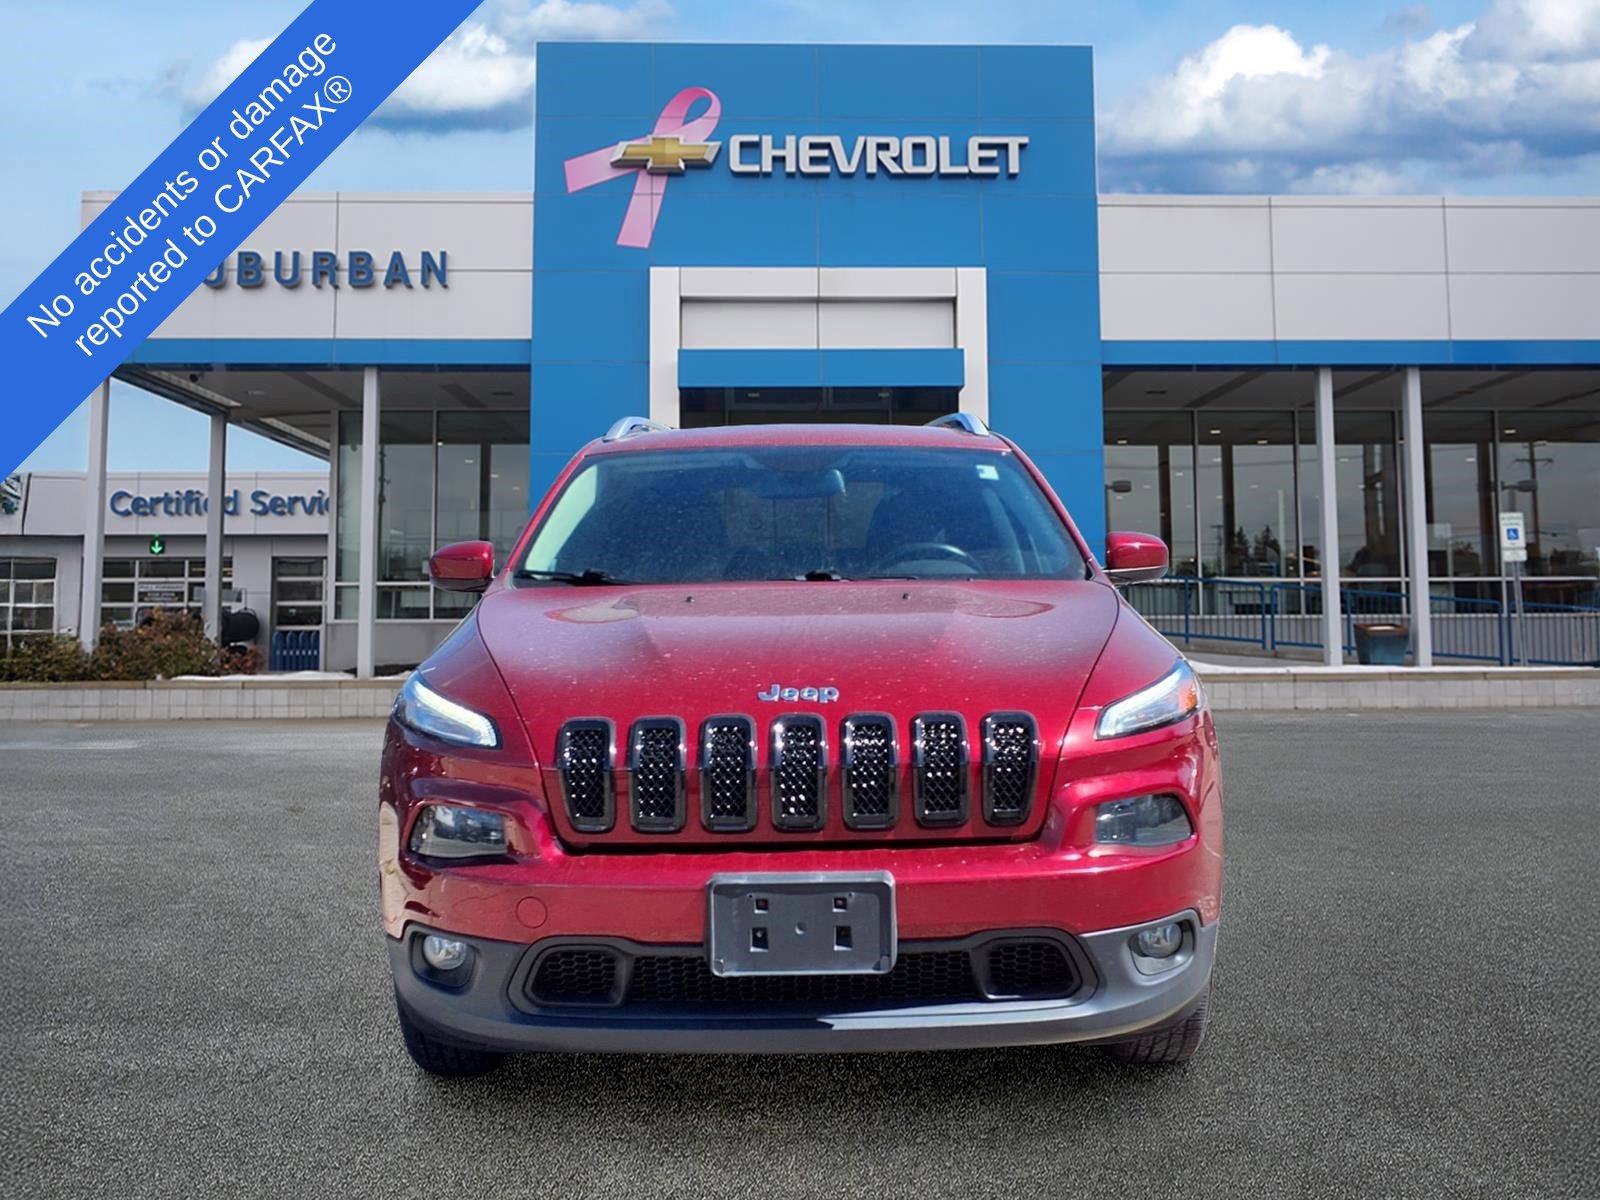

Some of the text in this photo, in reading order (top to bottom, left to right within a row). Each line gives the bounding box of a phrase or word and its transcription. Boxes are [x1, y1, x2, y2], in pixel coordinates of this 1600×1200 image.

[729, 134, 1029, 177] CHEVROLET
[110, 489, 240, 517] Certifid
[757, 683, 840, 704] Jeep
